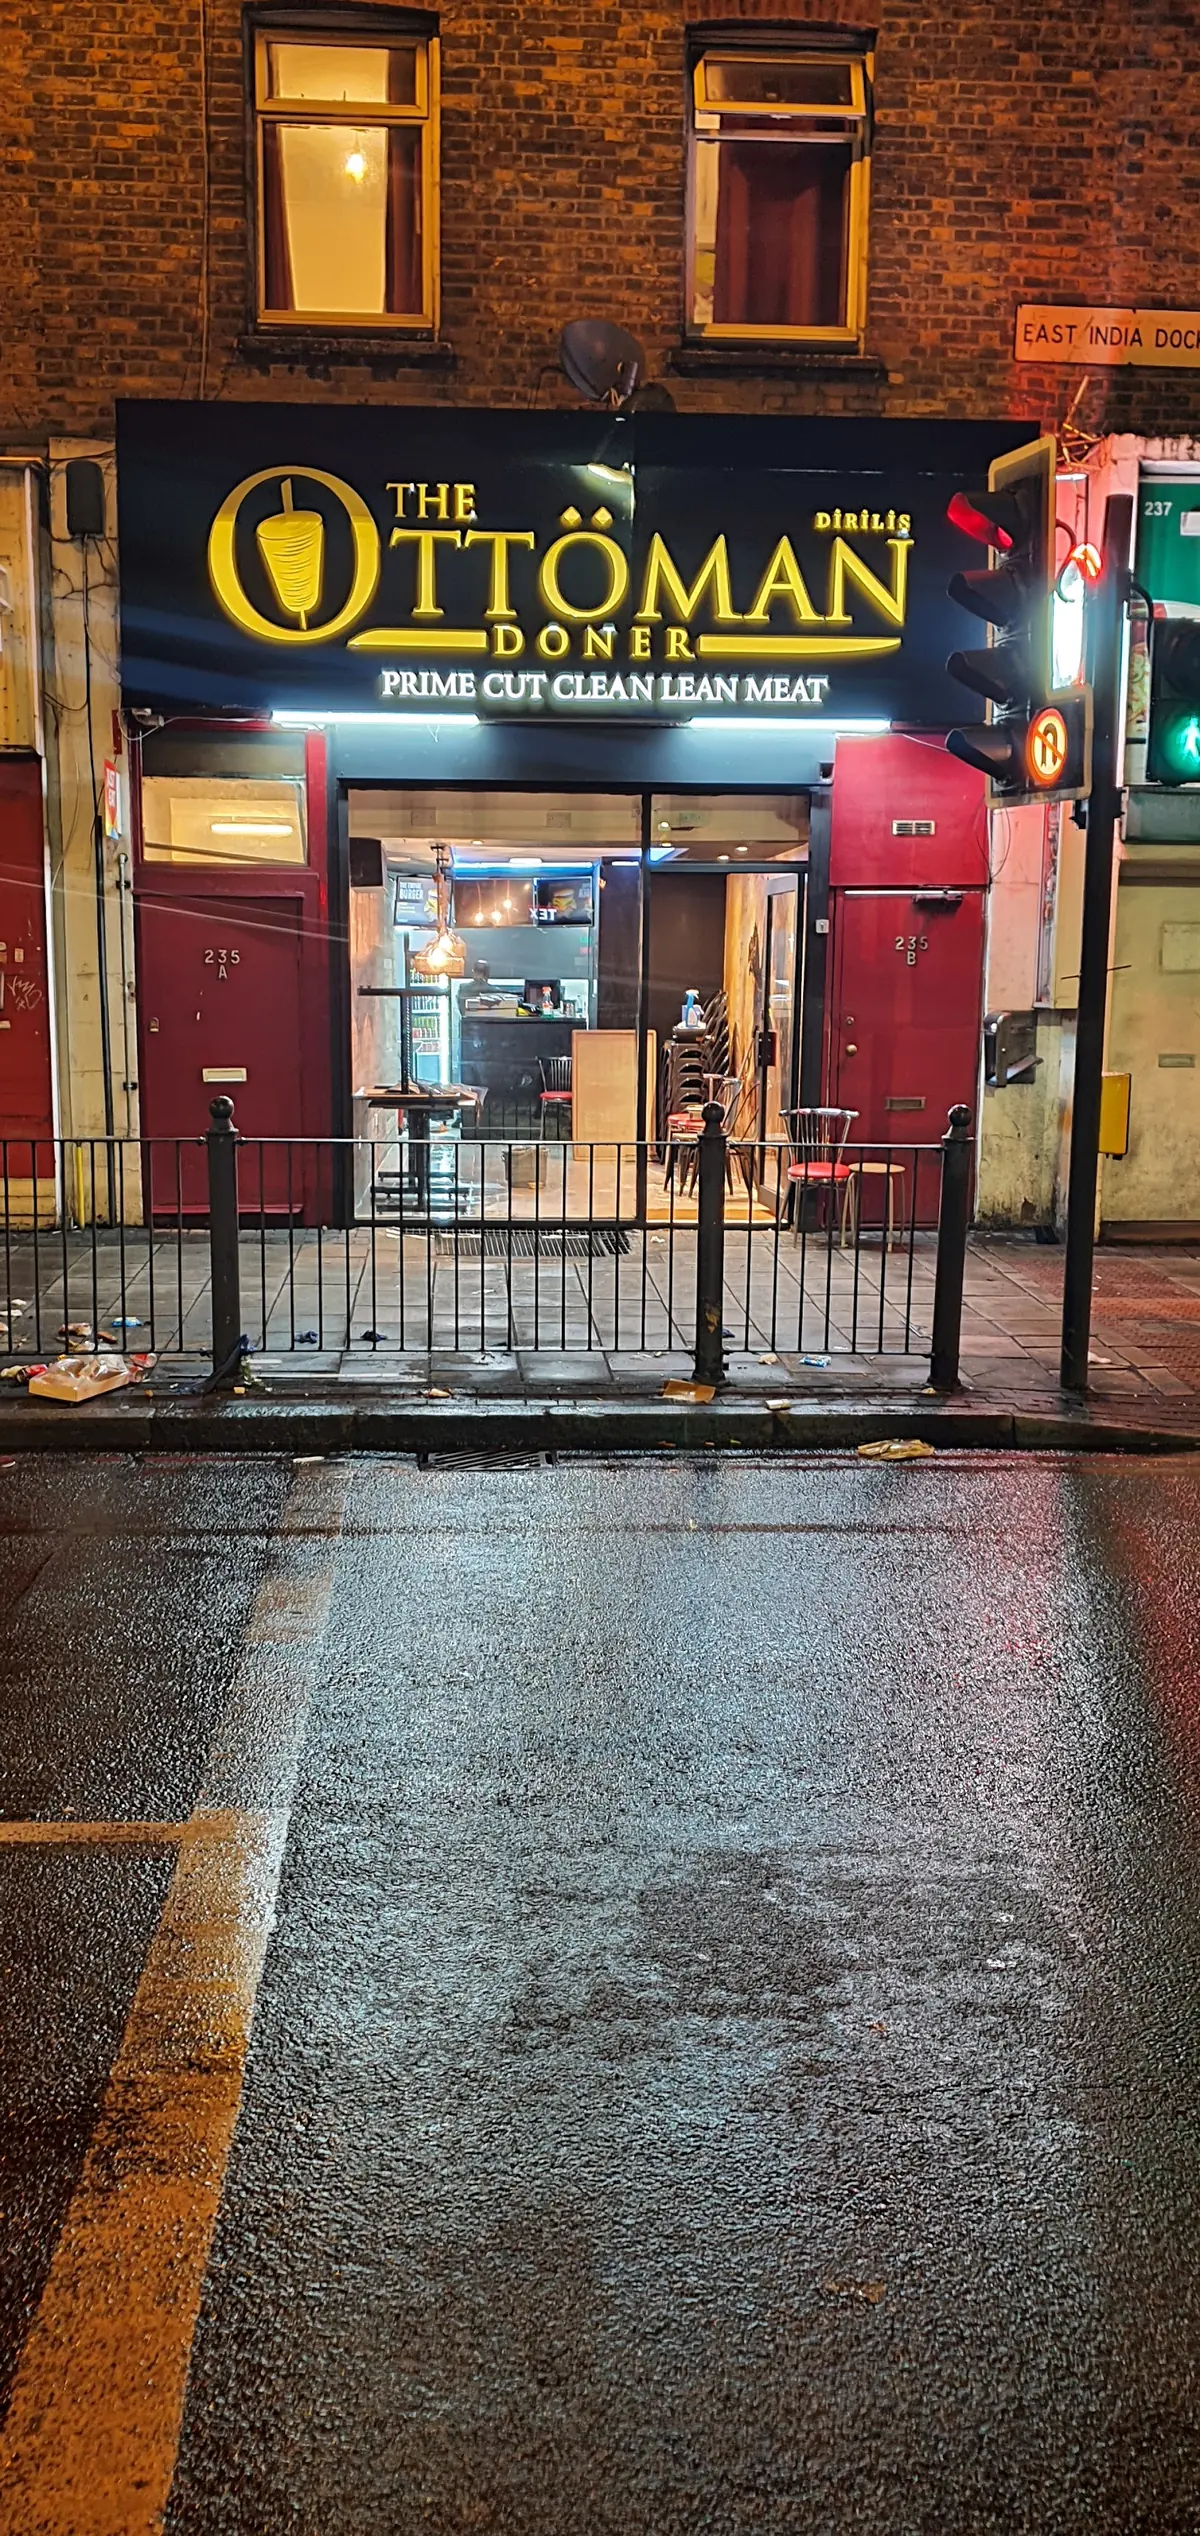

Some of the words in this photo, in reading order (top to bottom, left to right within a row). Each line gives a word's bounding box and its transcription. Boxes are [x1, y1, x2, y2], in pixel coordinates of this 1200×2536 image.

[1023, 323, 1078, 344] EAST
[1089, 326, 1143, 347] INDIA
[386, 482, 477, 521] THE
[1144, 501, 1173, 516] 237
[493, 623, 696, 659] DONER
[381, 669, 477, 698] PRIME
[483, 672, 547, 700] CUT
[553, 672, 654, 702] CLEAN
[660, 674, 740, 703] LEAN
[744, 674, 829, 703] MEAT
[895, 936, 929, 950] 235
[204, 949, 241, 964] 235
[907, 951, 916, 965] B
[218, 964, 228, 979] A
